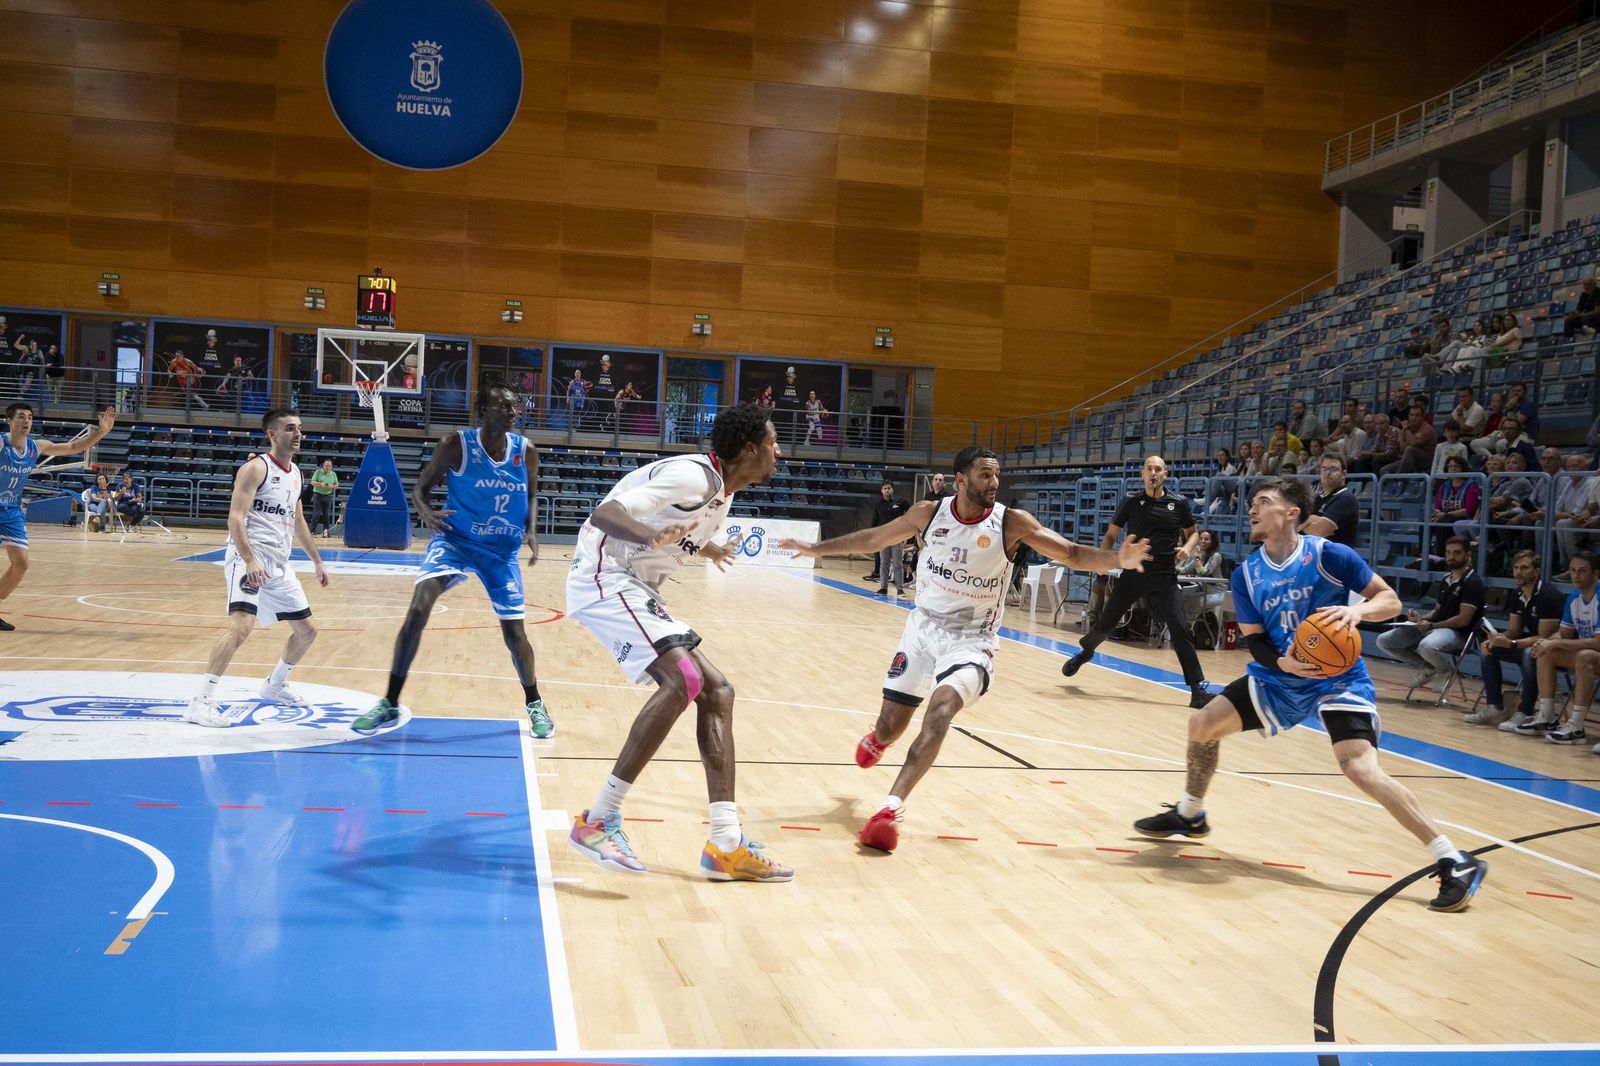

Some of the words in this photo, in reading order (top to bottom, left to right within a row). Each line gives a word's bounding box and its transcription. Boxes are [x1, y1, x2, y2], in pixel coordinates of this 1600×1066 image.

[397, 92, 442, 103] Ayuntamiento
[443, 96, 452, 104] de
[396, 101, 451, 117] HUELVA
[368, 277, 390, 289] 7:07
[369, 292, 387, 310] 17
[358, 314, 391, 322] HUELVA
[400, 399, 422, 407] COPA
[8, 476, 19, 489] 11
[494, 493, 511, 514] 12
[424, 547, 446, 564] 12
[949, 546, 968, 565] 31
[1280, 610, 1300, 634] 40
[1227, 629, 1236, 643] 5
